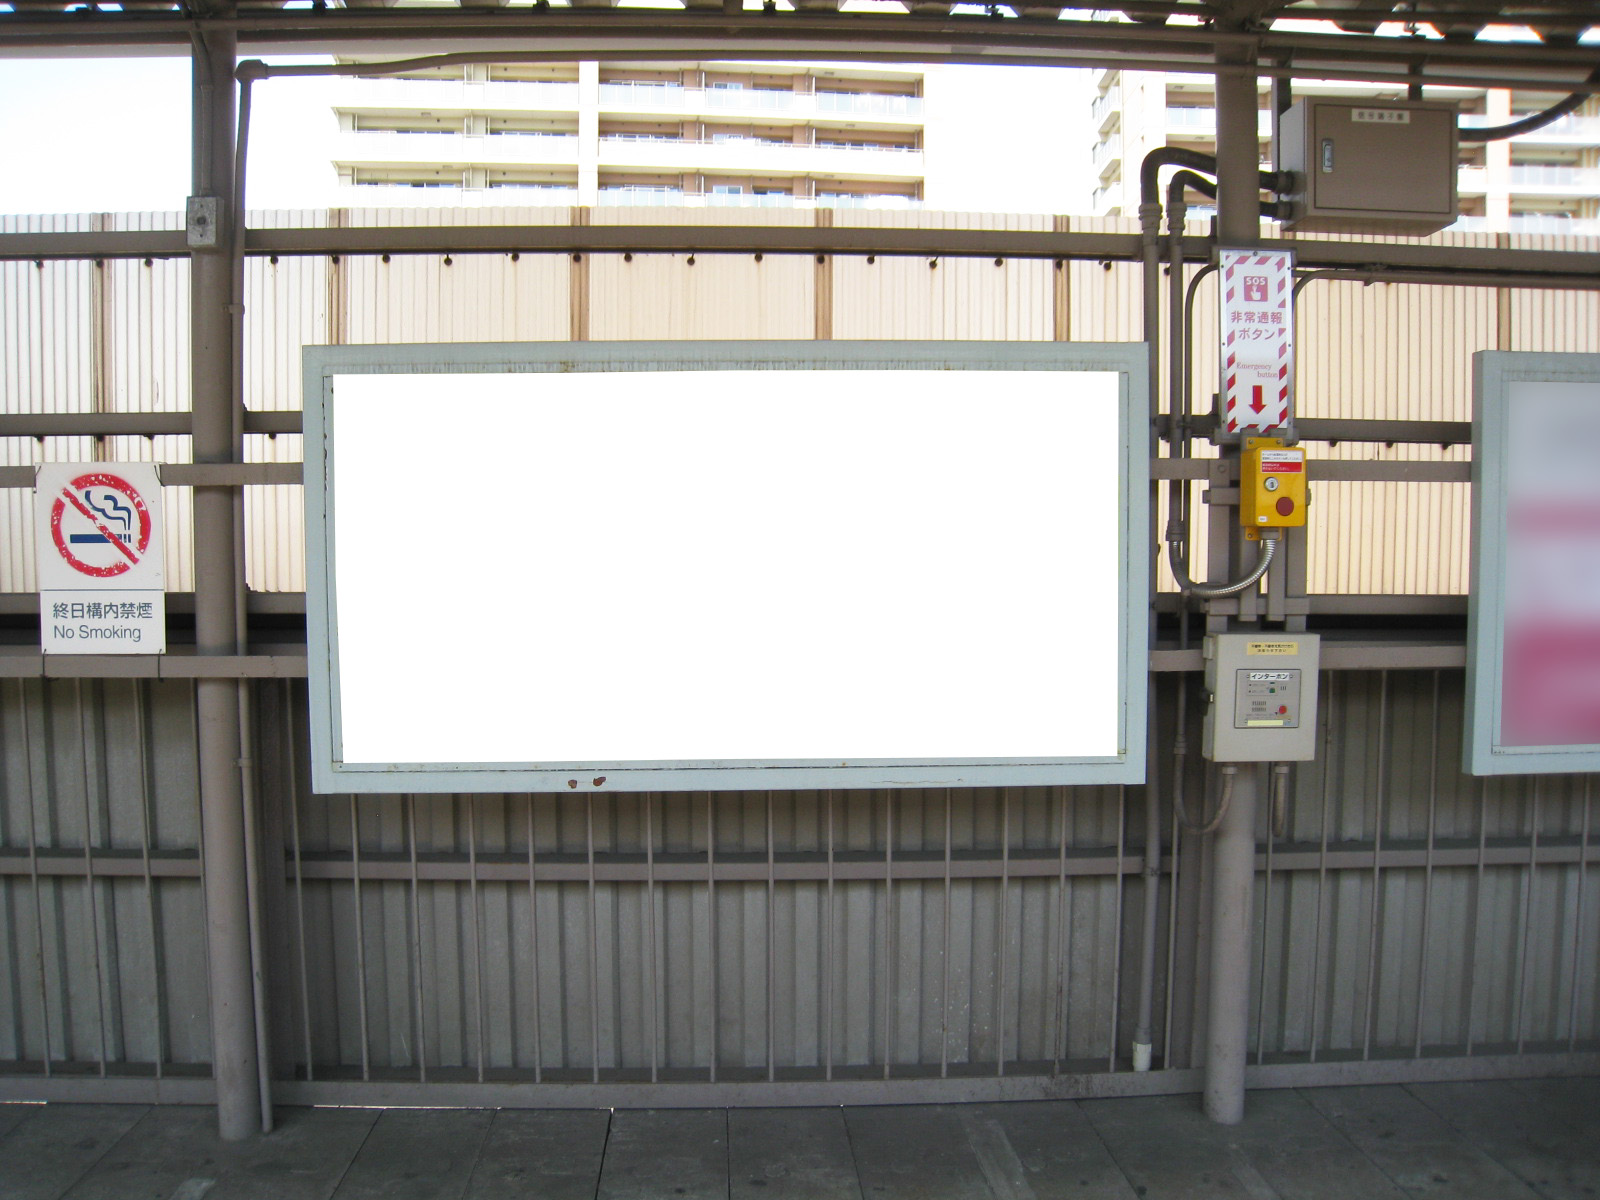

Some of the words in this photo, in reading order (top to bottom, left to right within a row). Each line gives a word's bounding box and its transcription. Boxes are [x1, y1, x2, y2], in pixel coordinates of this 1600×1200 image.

[1246, 277, 1266, 286] SOS
[1231, 311, 1282, 324] 非常通報
[1239, 328, 1275, 340] ボタン
[1236, 362, 1272, 371] Emergency
[1257, 371, 1278, 379] button
[52, 602, 153, 619] 終日構内禁煙
[54, 625, 75, 639] No
[79, 625, 141, 642] Smoking
